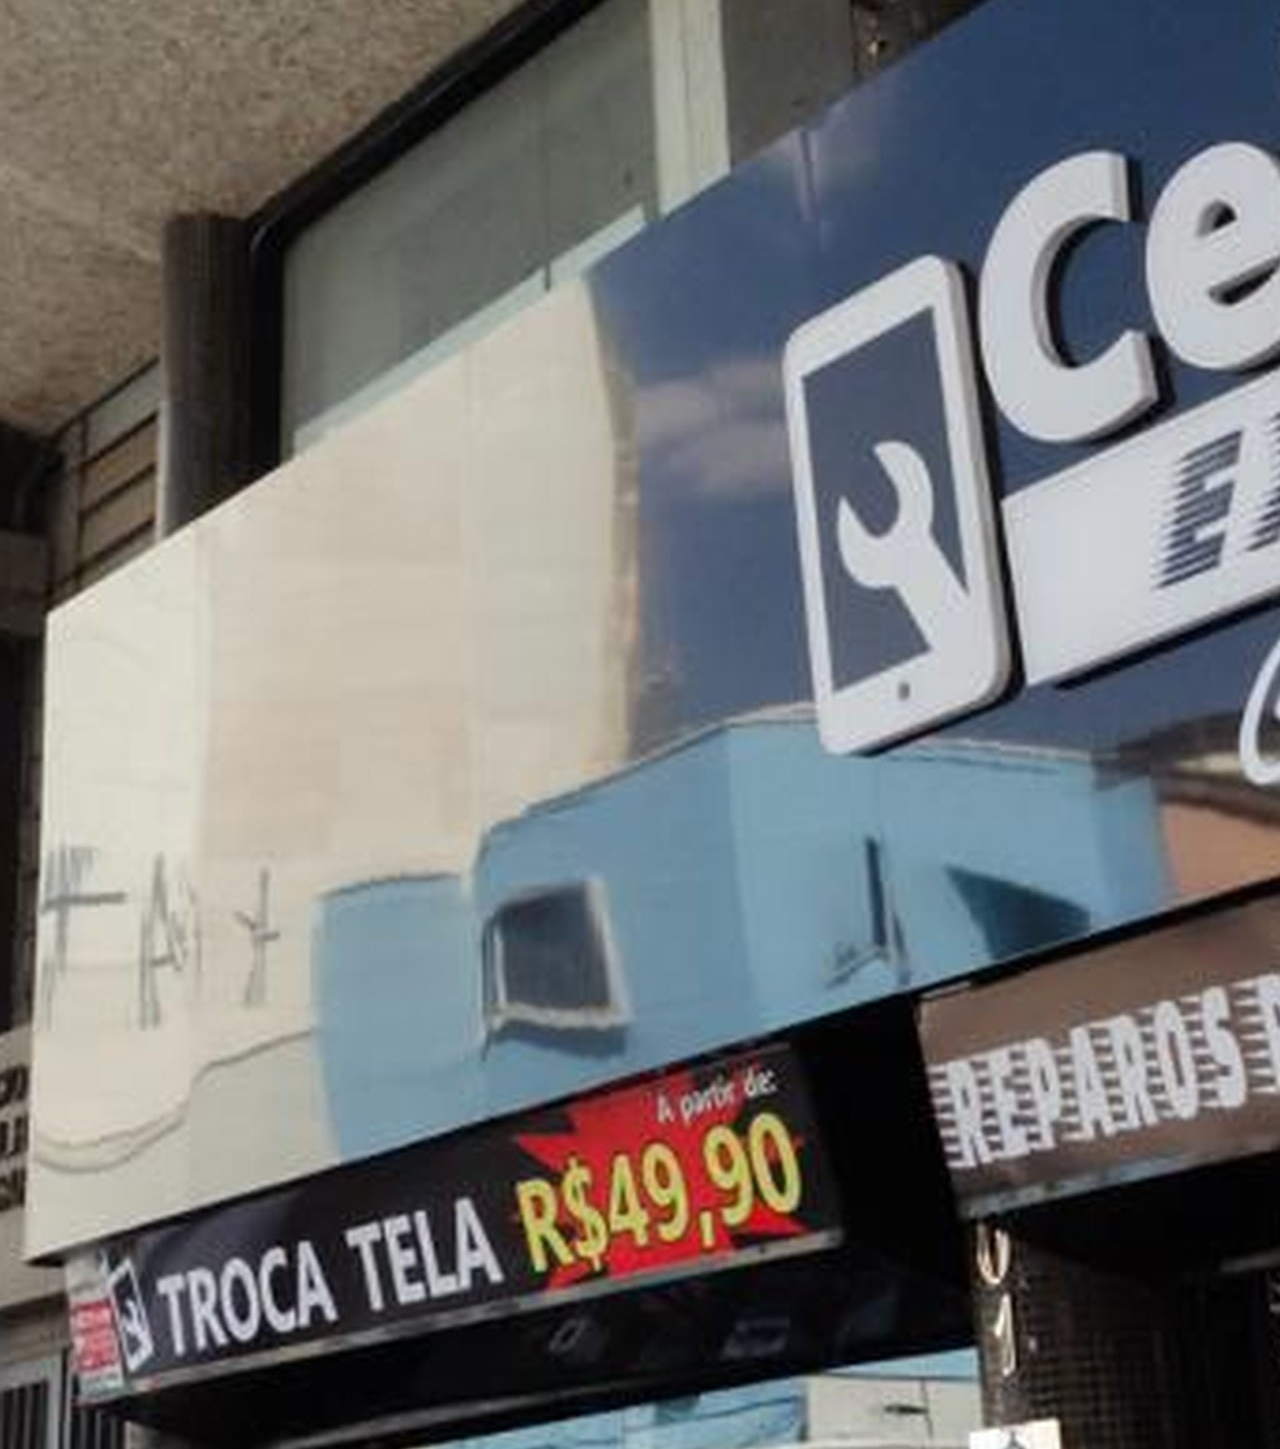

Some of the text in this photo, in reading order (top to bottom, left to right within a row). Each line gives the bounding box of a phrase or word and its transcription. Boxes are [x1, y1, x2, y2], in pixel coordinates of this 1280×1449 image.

[925, 987, 1246, 1167] REPAROS
[157, 1246, 336, 1359] TROCA
[346, 1196, 506, 1307] TELA
[517, 1109, 803, 1273] R$49,90
